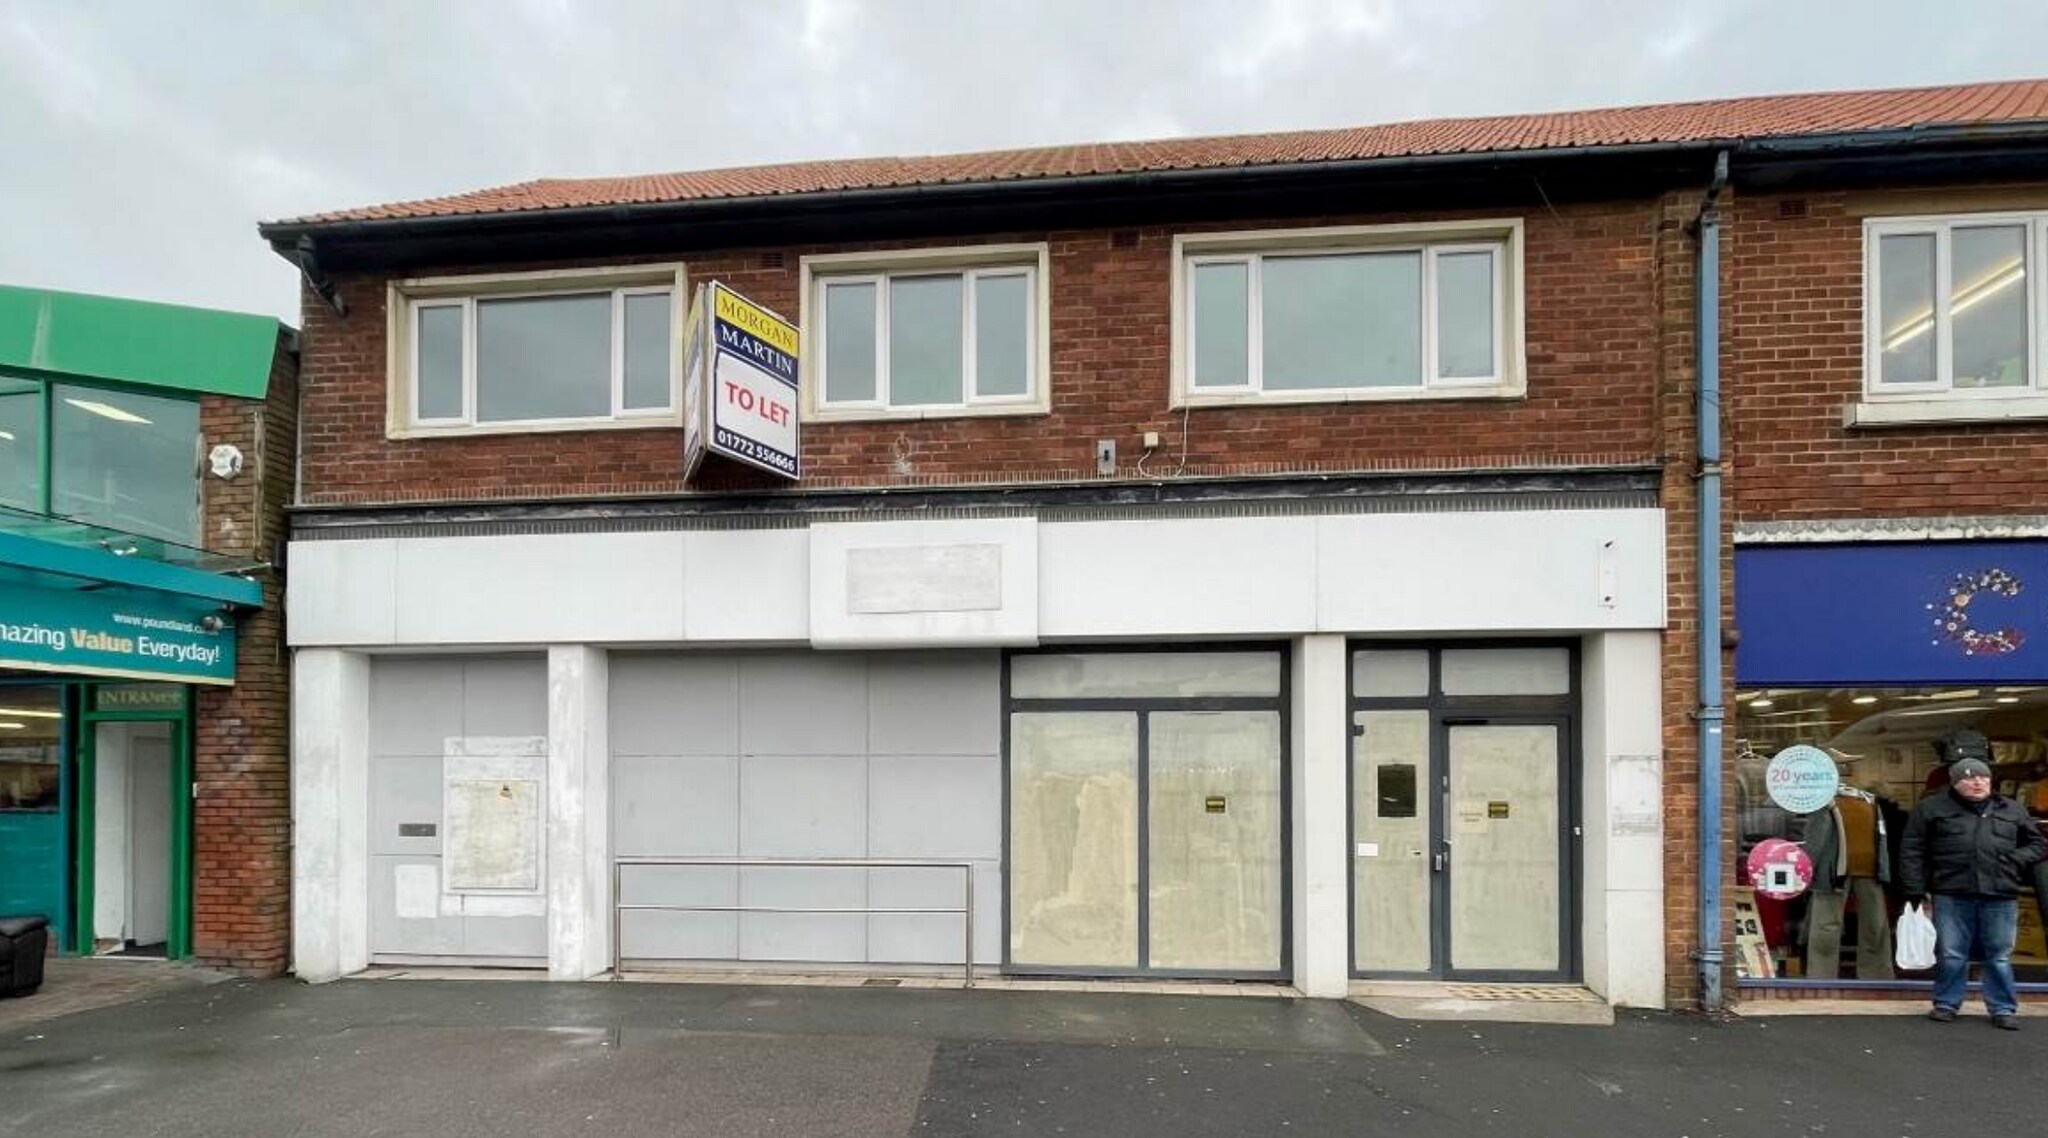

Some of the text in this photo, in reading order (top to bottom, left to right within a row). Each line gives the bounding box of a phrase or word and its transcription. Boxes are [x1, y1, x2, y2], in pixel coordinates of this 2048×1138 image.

[722, 298, 794, 348] MORGAN
[721, 324, 793, 376] MARTIN
[725, 381, 789, 428] TO LET
[717, 431, 795, 472] 01772 556666
[70, 627, 133, 653] Value
[138, 635, 220, 666] Everyday!
[1771, 768, 1790, 783] 20
